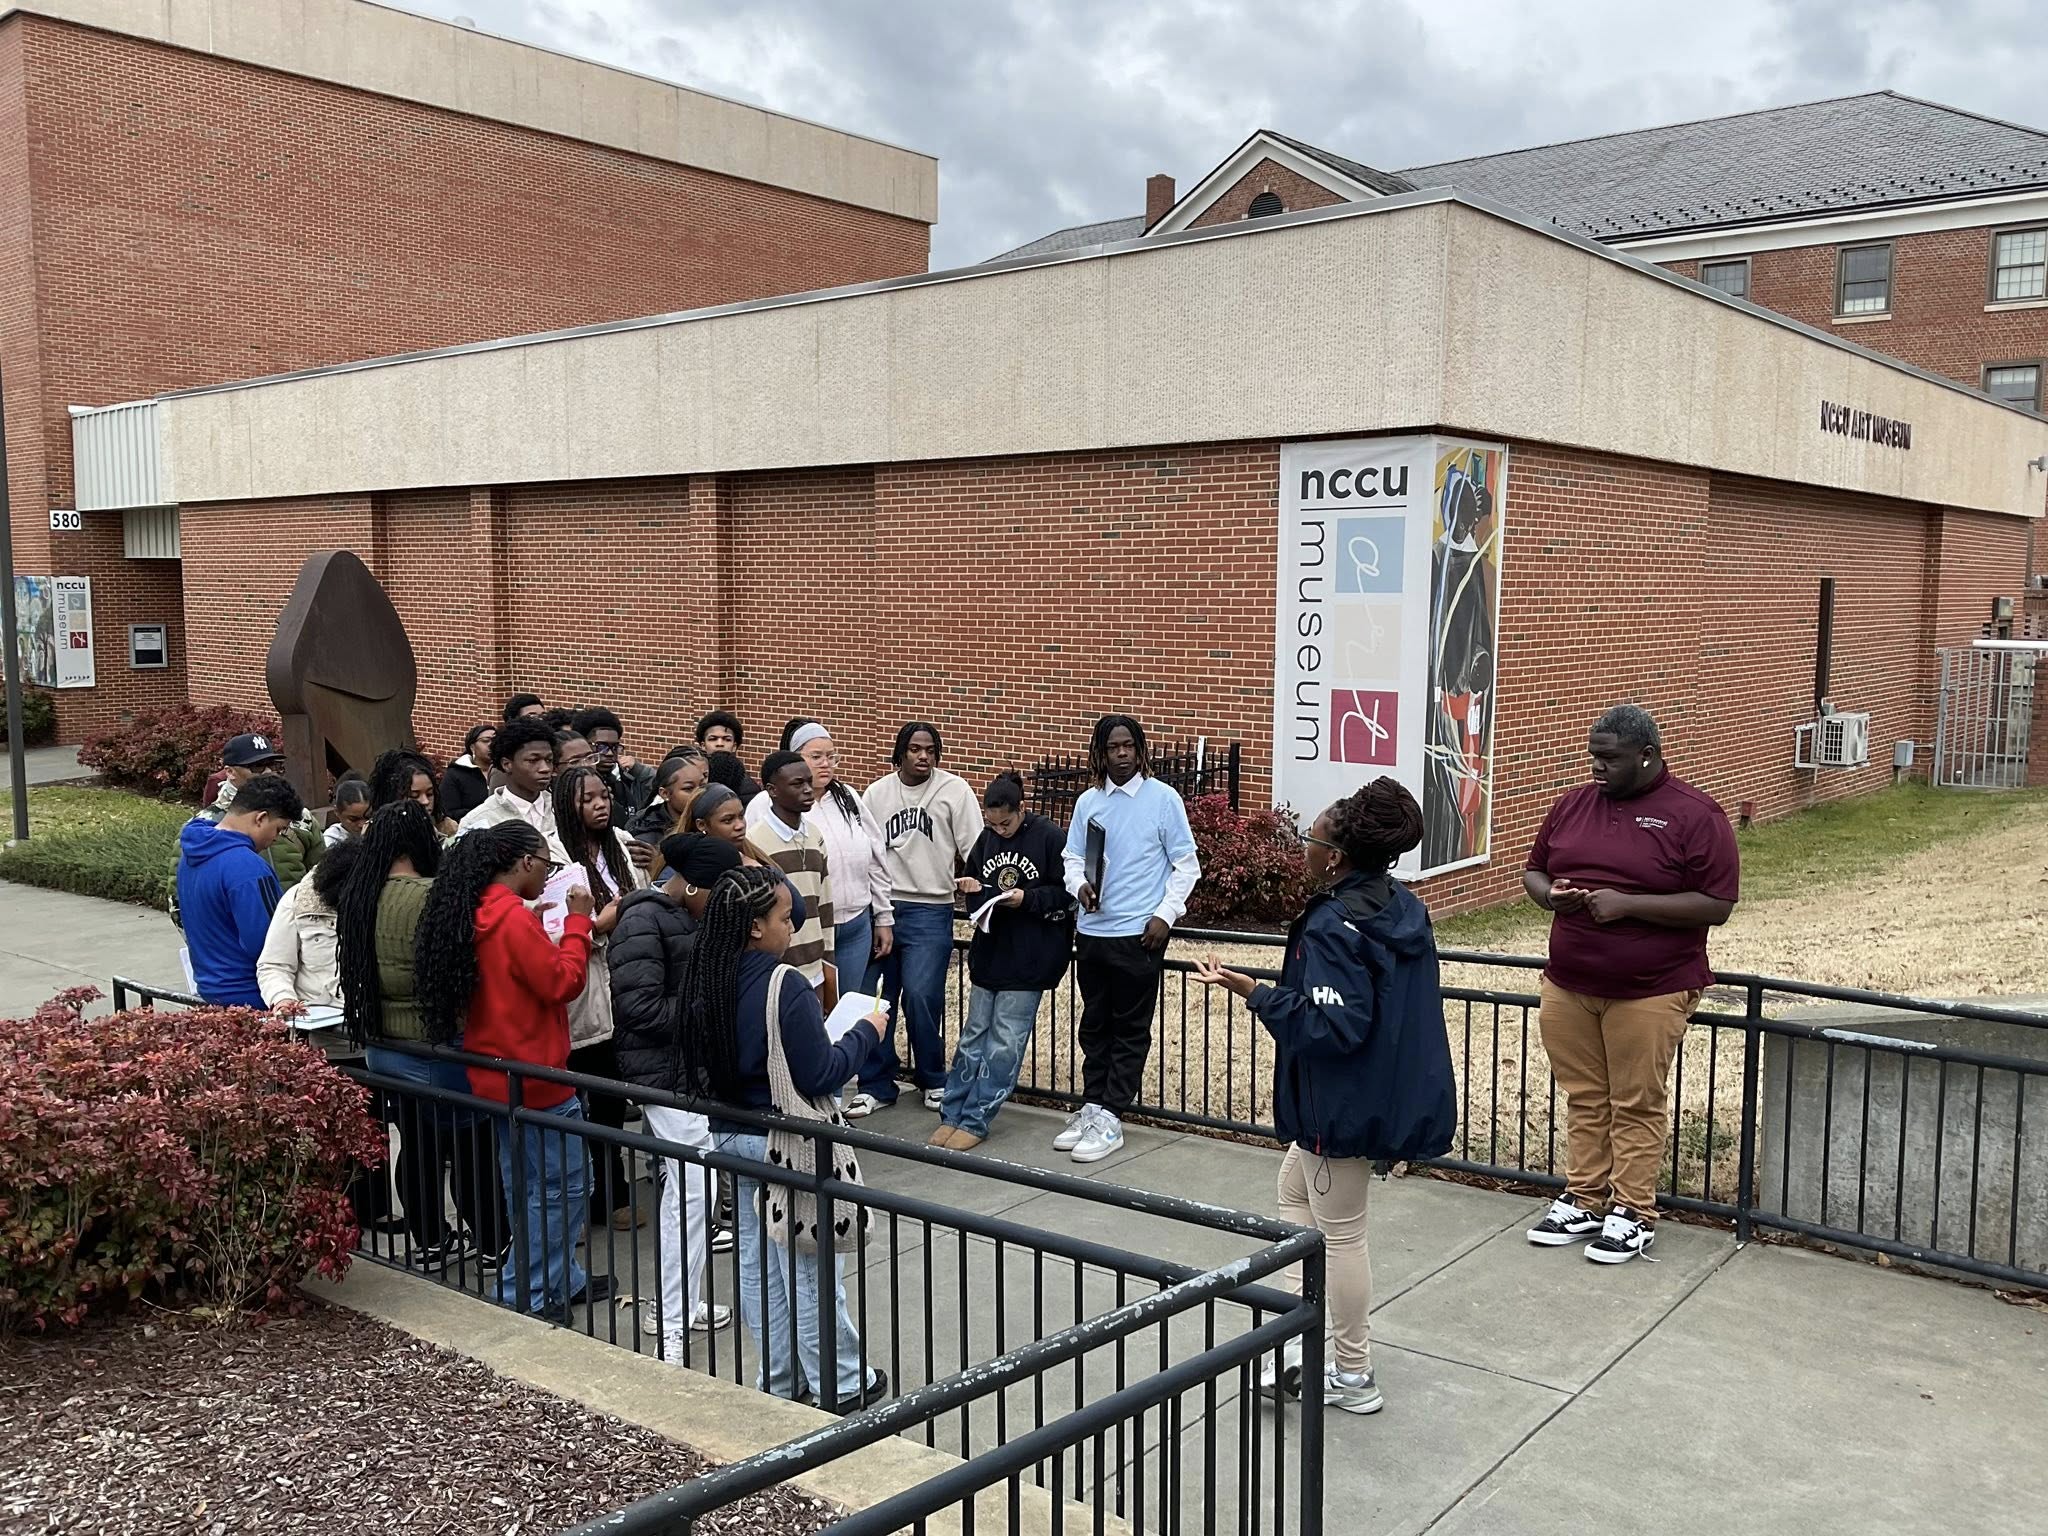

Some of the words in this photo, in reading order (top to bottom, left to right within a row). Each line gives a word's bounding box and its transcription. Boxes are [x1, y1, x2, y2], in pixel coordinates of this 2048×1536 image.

[1820, 400, 1850, 436] NCCU
[1850, 409, 1872, 442] ART
[1872, 415, 1912, 450] MUSEUM
[1300, 465, 1409, 500] nccu
[52, 513, 80, 528] 580
[56, 582, 86, 590] nccu
[58, 593, 68, 650] museum
[1295, 520, 1325, 762] museum
[885, 807, 934, 847] JORDAN
[982, 851, 1040, 880] HOGWARTS
[1312, 986, 1345, 1006] HH
